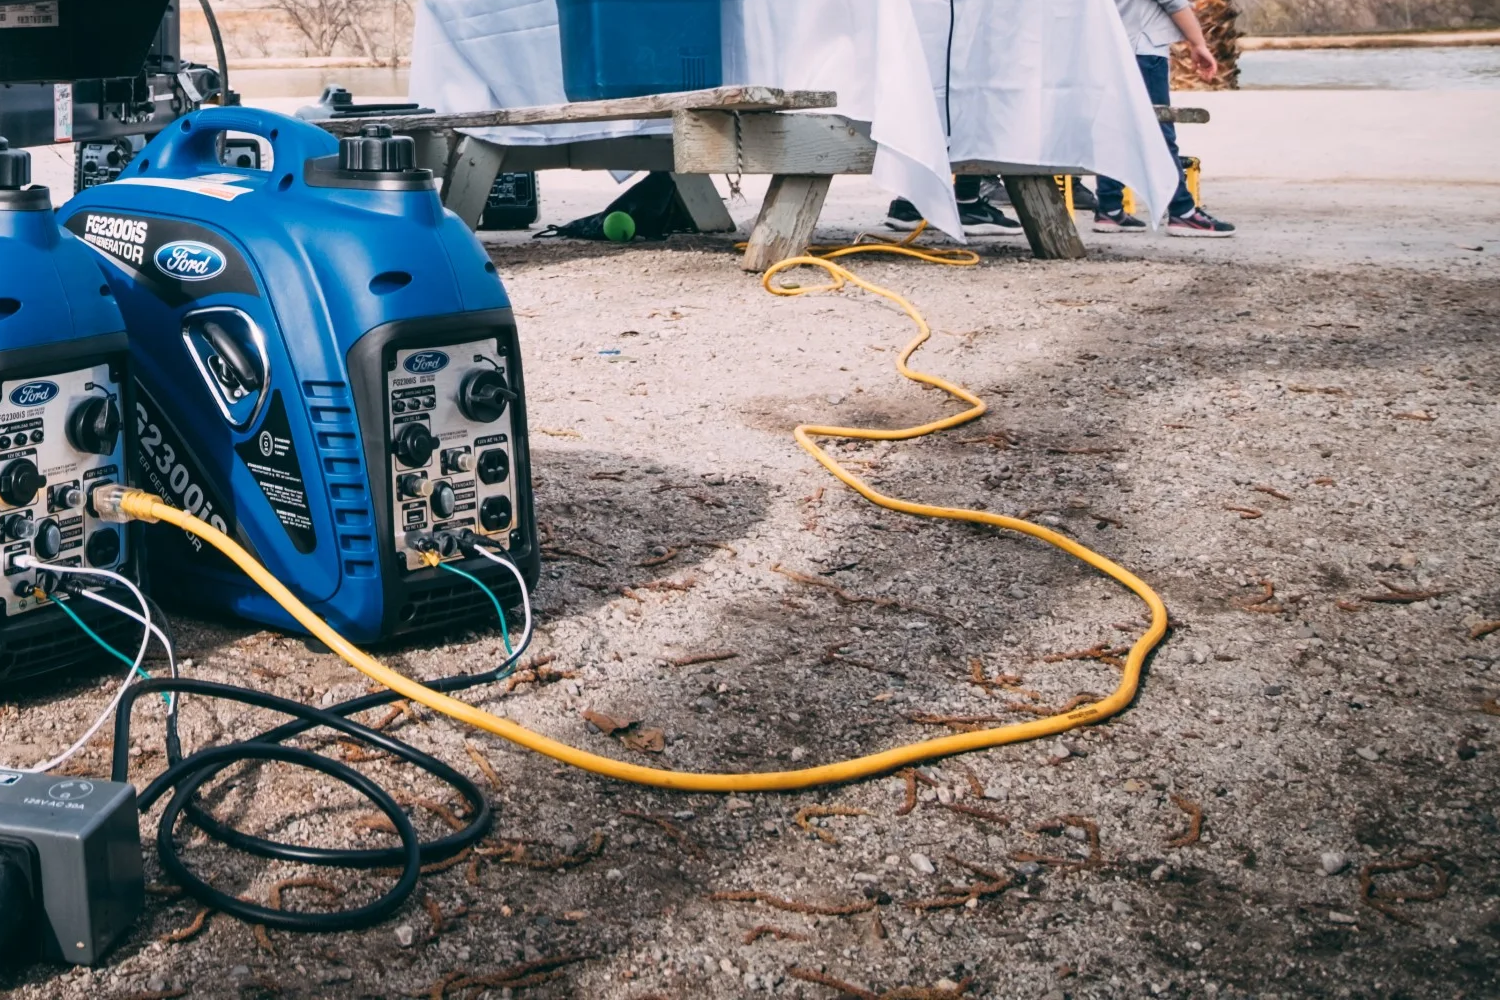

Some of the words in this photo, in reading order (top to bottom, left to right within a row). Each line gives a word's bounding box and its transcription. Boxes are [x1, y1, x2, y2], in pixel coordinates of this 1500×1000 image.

[85, 214, 148, 244] FG2300iS
[95, 236, 144, 265] GENERATOR
[167, 246, 208, 274] Ford
[412, 354, 440, 371] Ford
[19, 385, 49, 403] Ford
[456, 492, 474, 500] CONOMY
